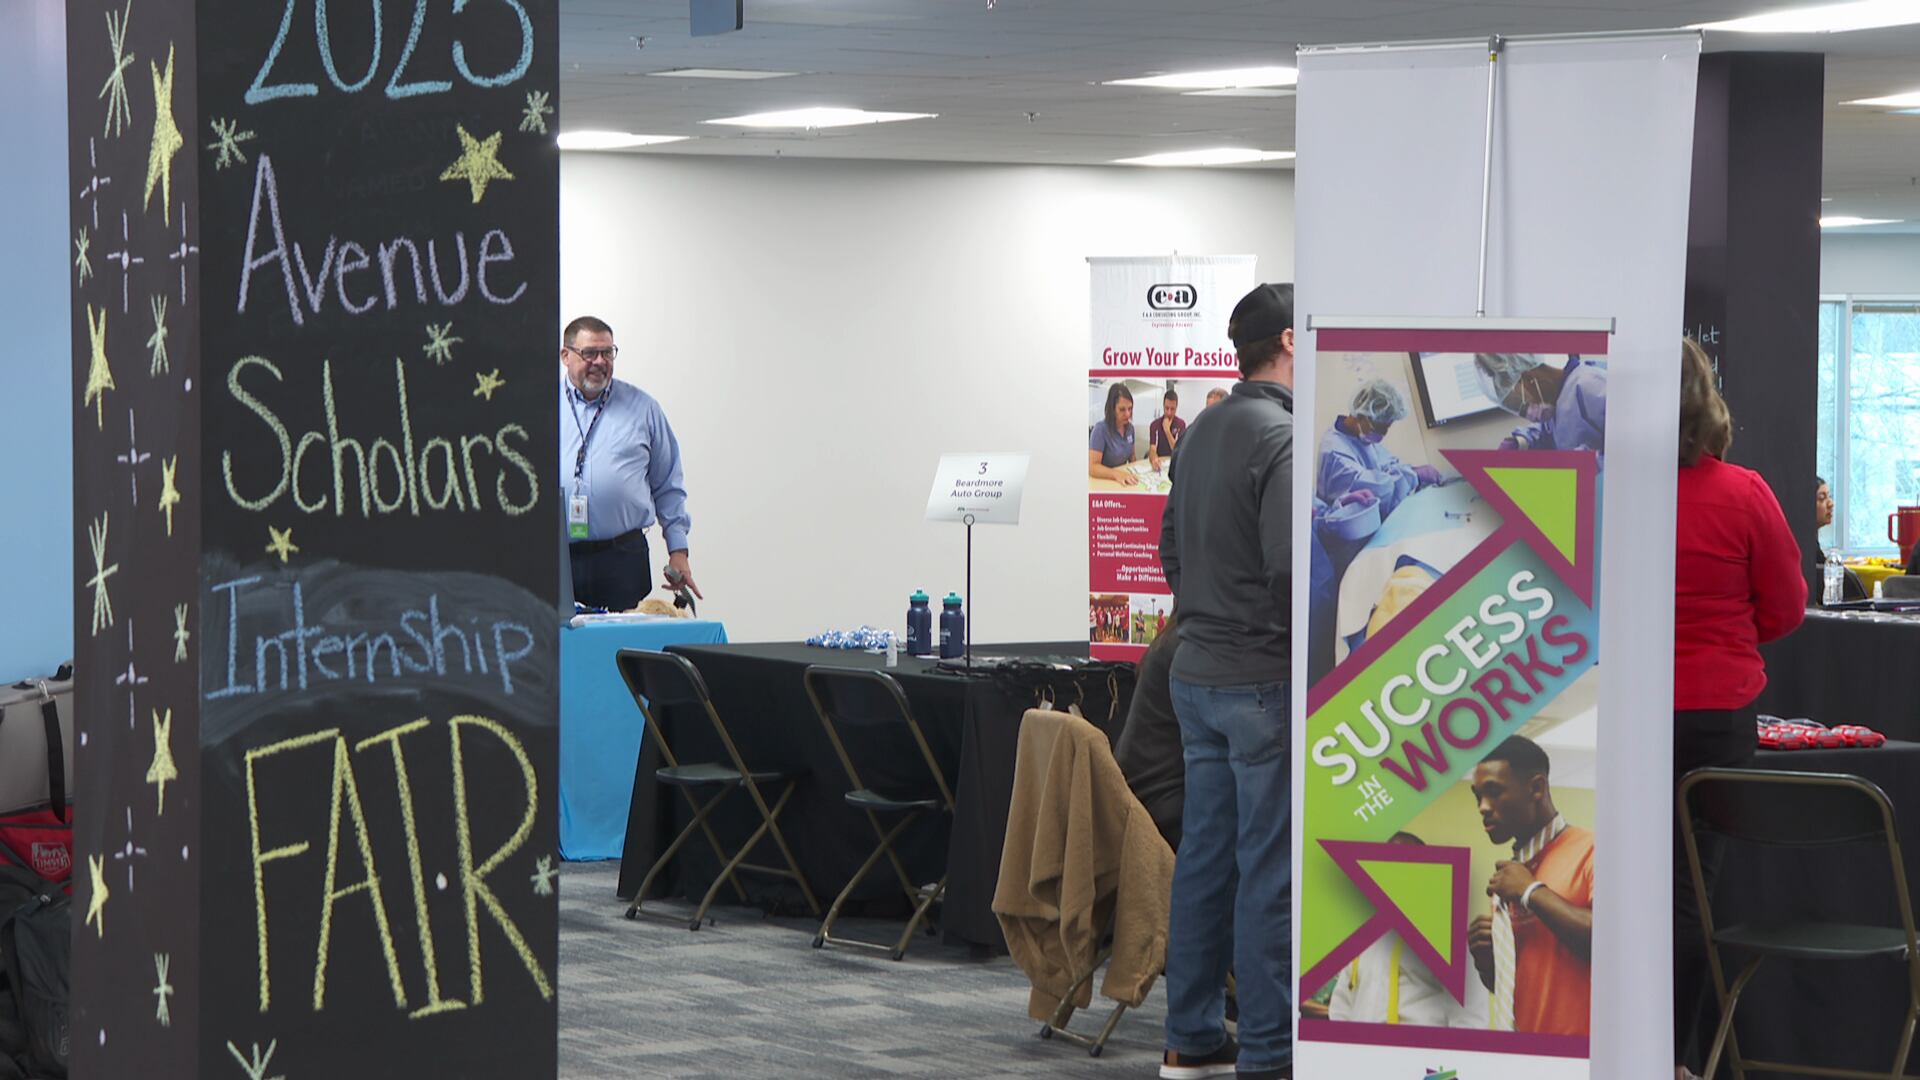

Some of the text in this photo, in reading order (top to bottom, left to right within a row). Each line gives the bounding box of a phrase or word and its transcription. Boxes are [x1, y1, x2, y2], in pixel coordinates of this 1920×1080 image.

[245, 0, 534, 104] 2025
[237, 153, 527, 325] Avenue
[1102, 347, 1141, 366] Grow
[1145, 347, 1179, 366] Your
[222, 355, 539, 518] Scholars
[978, 461, 988, 475] 3
[950, 489, 1003, 499] Auto Group
[955, 479, 1004, 488] Beardmore
[1092, 500, 1103, 508] E&A
[1120, 525, 1149, 533] Opportunities
[1097, 542, 1114, 550] Training
[1117, 573, 1131, 581] Make
[206, 575, 535, 699] Internship
[1312, 570, 1553, 785] SUCCESS
[1379, 615, 1589, 793] WORKS
[1356, 774, 1383, 800] IN
[1353, 787, 1395, 823] THE
[245, 715, 554, 1019] FAIR
